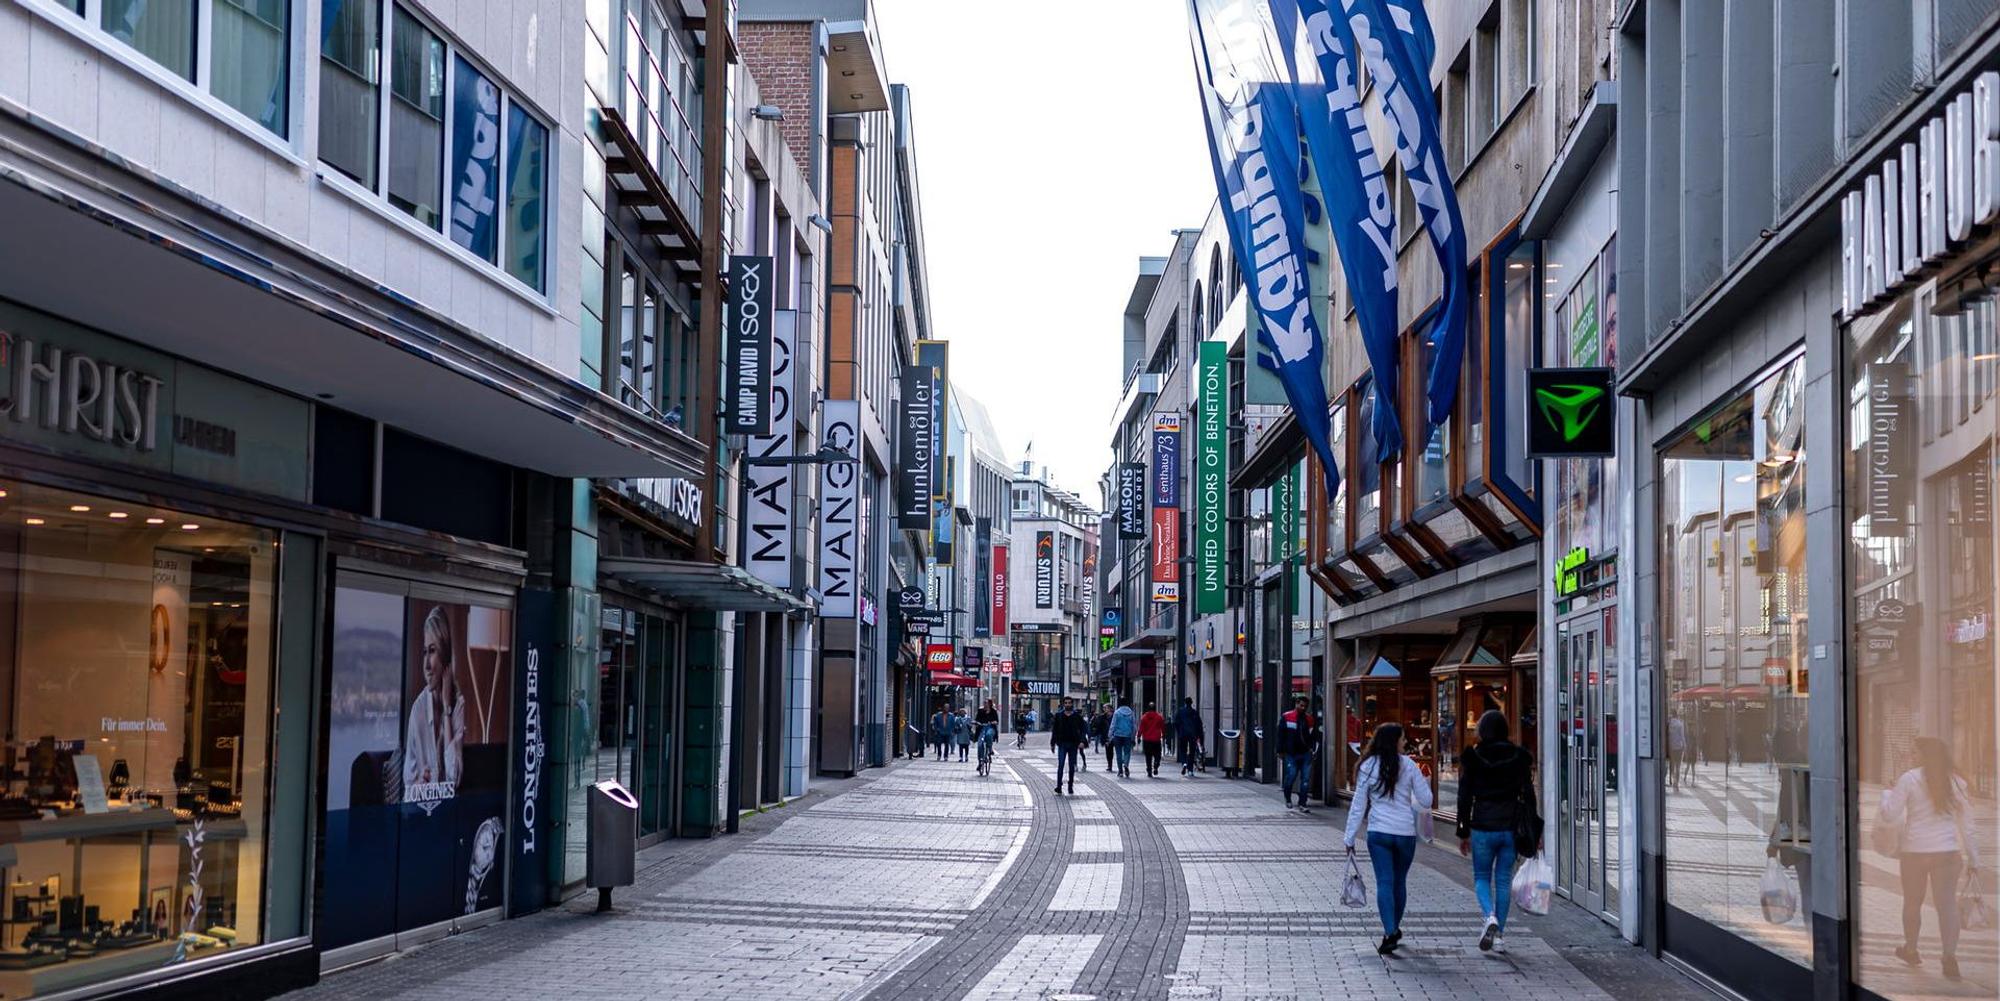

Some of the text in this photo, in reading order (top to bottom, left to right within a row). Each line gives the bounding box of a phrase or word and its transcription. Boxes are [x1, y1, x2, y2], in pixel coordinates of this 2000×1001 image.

[739, 347, 758, 387] DAVID
[738, 389, 757, 426] CAMP
[1159, 414, 1177, 426] dm
[906, 380, 929, 515] hunkemöller
[1158, 454, 1169, 504] Eenthaus
[1205, 362, 1219, 591] UNITED COLORS OF BENETTON.
[824, 421, 854, 598] MANGO
[1122, 468, 1133, 533] MAISONS
[1136, 518, 1142, 534] DU
[995, 574, 1004, 607] UNIQLO
[1038, 558, 1051, 605] SATURN
[1157, 584, 1175, 595] dm
[907, 622, 928, 633] VANS
[930, 652, 951, 662] LEGO
[1027, 681, 1061, 694] SATURN
[101, 718, 168, 732] Für immer Dein.
[524, 648, 540, 854] LONGINES
[403, 781, 456, 803] LONGINES
